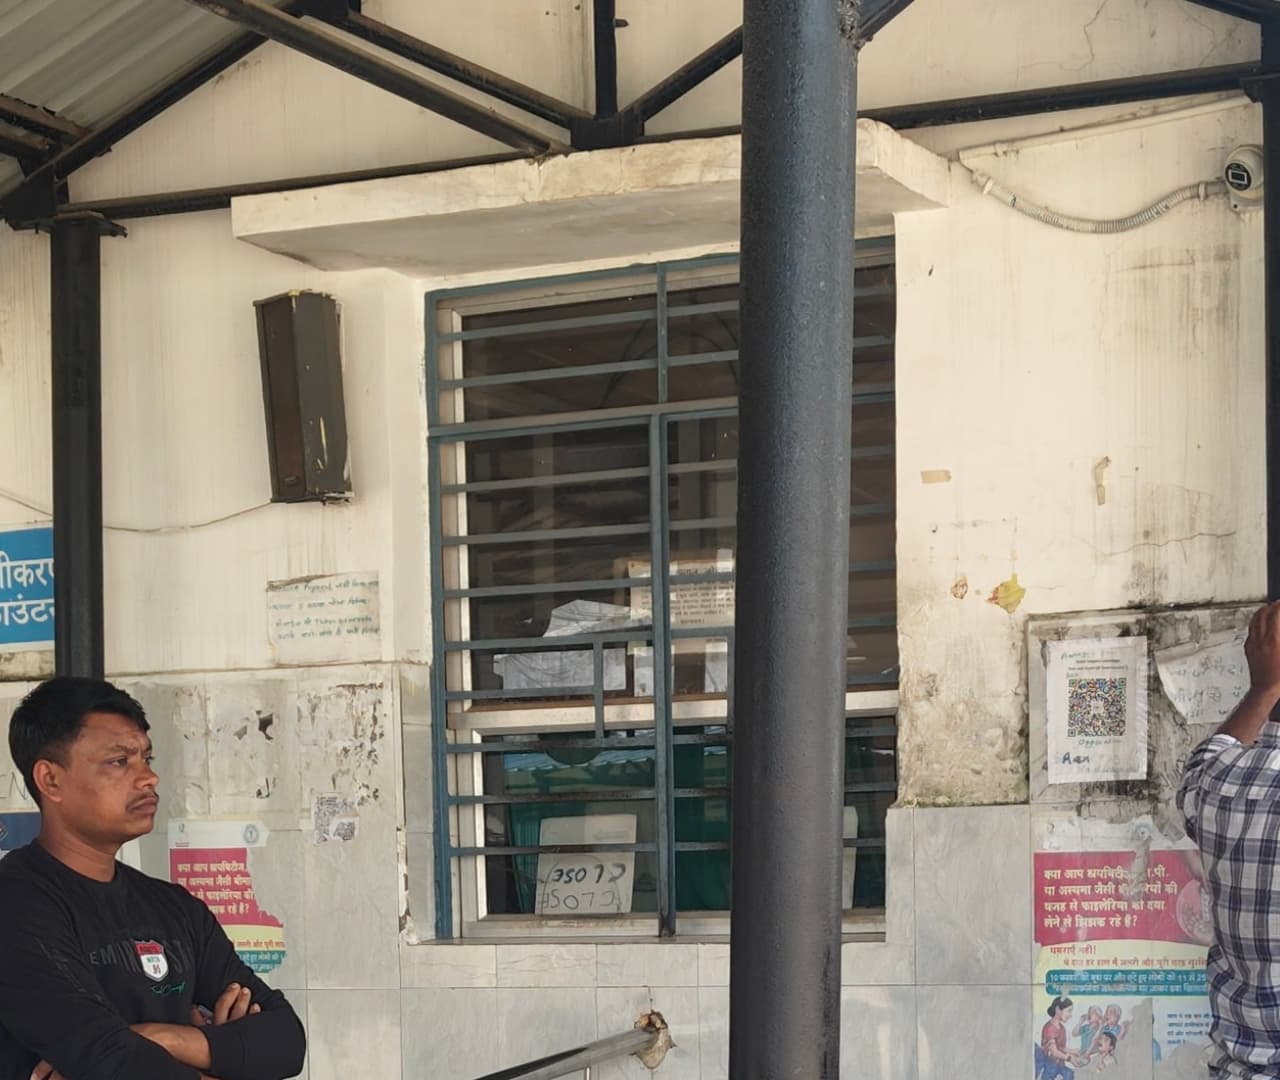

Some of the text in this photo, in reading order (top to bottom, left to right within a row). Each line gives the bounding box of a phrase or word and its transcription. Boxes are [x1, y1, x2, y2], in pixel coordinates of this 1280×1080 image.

[550, 863, 627, 885] CLOSE
[1043, 869, 1062, 880] क्या
[1064, 869, 1084, 880] आप
[1164, 881, 1179, 895] की
[1069, 899, 1078, 911] से
[1043, 915, 1060, 929] लेने
